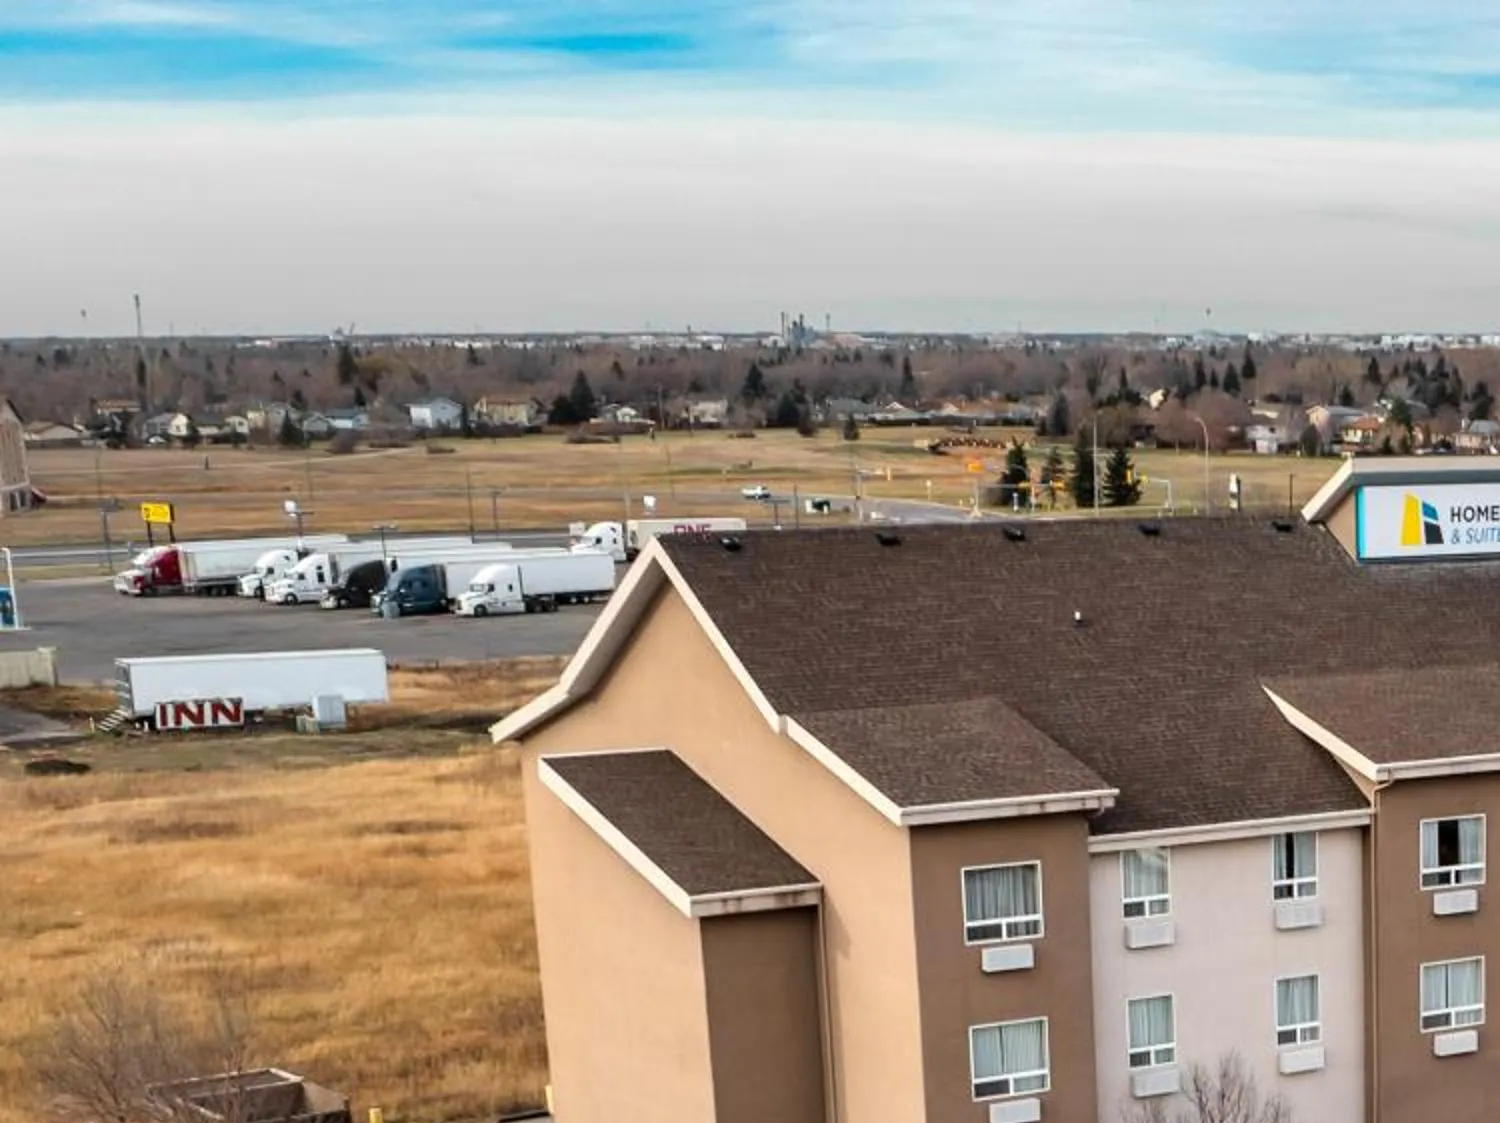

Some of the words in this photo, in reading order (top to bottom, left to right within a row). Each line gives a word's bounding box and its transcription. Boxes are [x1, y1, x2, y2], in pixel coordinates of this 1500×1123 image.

[1450, 505, 1500, 523] HOME
[1451, 527, 1461, 544] &
[160, 703, 241, 726] INN
